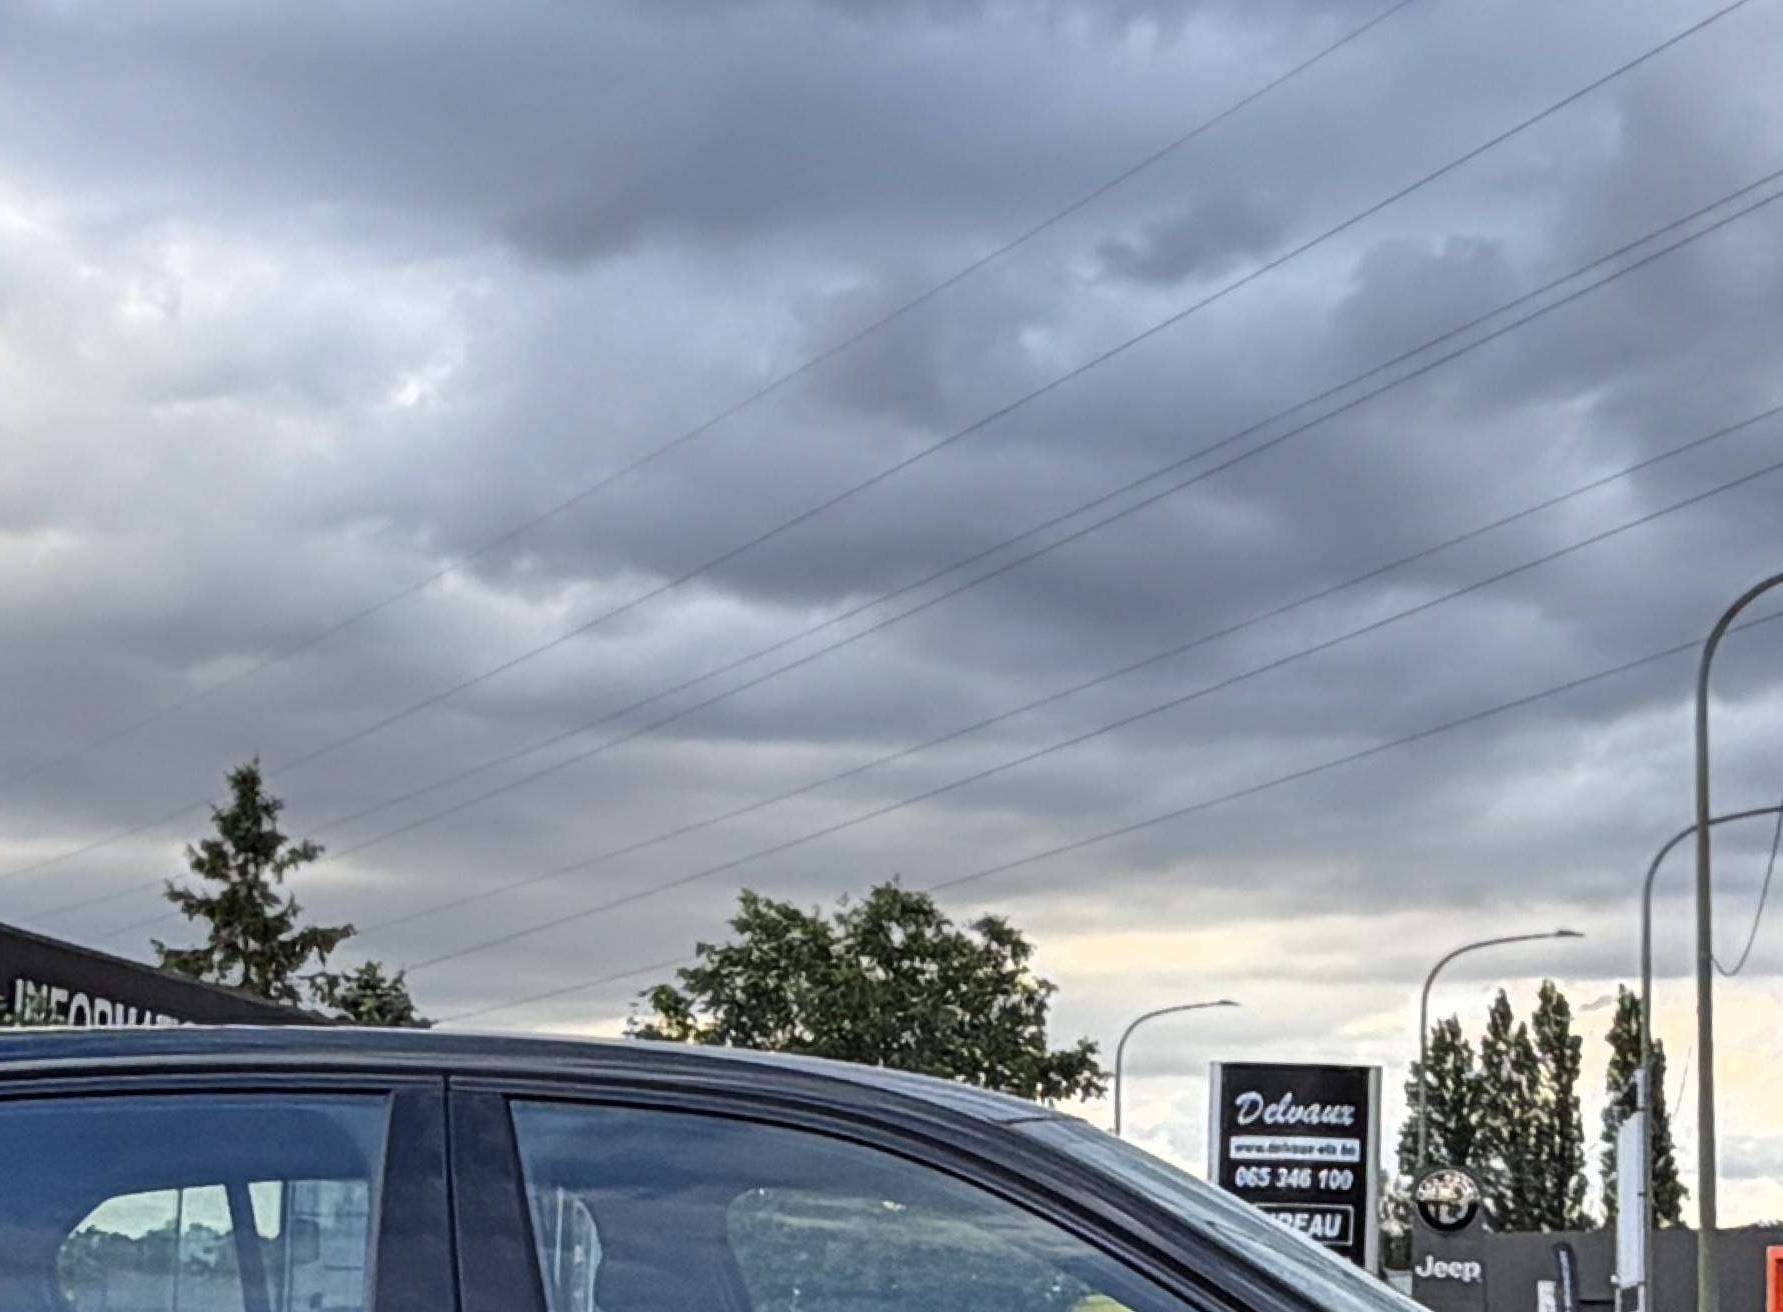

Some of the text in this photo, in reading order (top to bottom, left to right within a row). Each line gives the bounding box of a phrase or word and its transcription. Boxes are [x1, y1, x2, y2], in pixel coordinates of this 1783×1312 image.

[1235, 1090, 1356, 1126] Delvaux
[1235, 1166, 1354, 1191] 065 346 100
[1415, 1255, 1482, 1283] Jeep
